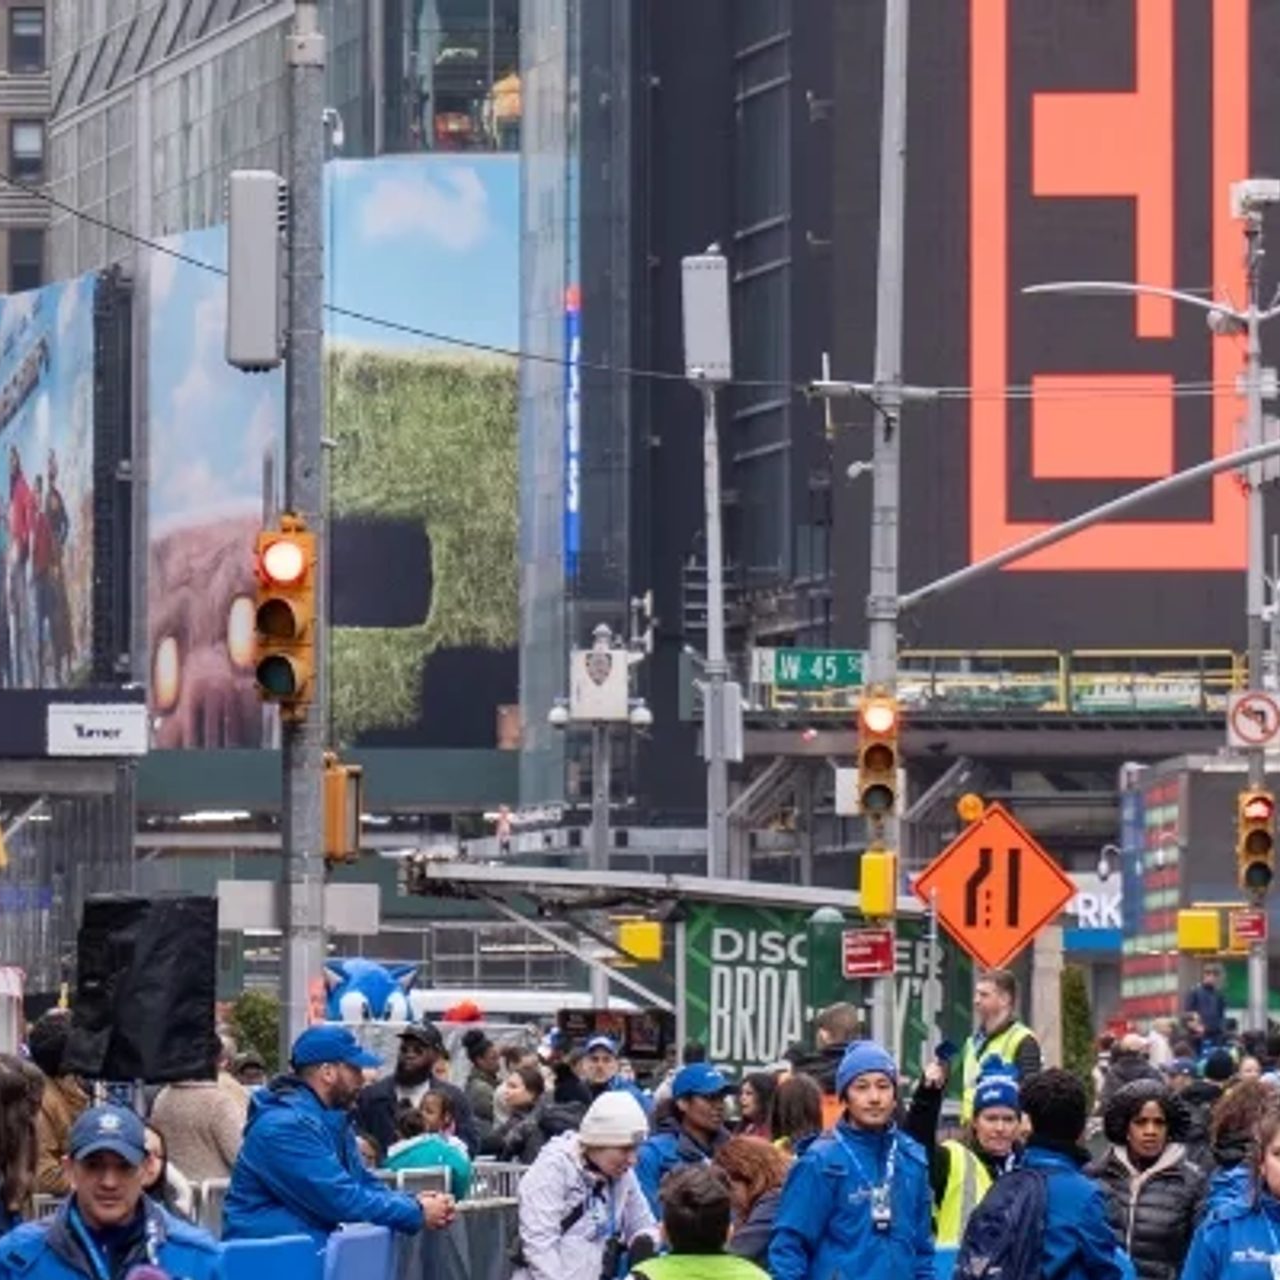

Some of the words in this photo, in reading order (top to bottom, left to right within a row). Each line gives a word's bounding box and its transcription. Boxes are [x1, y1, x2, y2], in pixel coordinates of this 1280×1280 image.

[780, 654, 801, 681] W
[809, 655, 838, 682] 45
[1065, 893, 1123, 929] RK
[711, 927, 945, 976] DISCER
